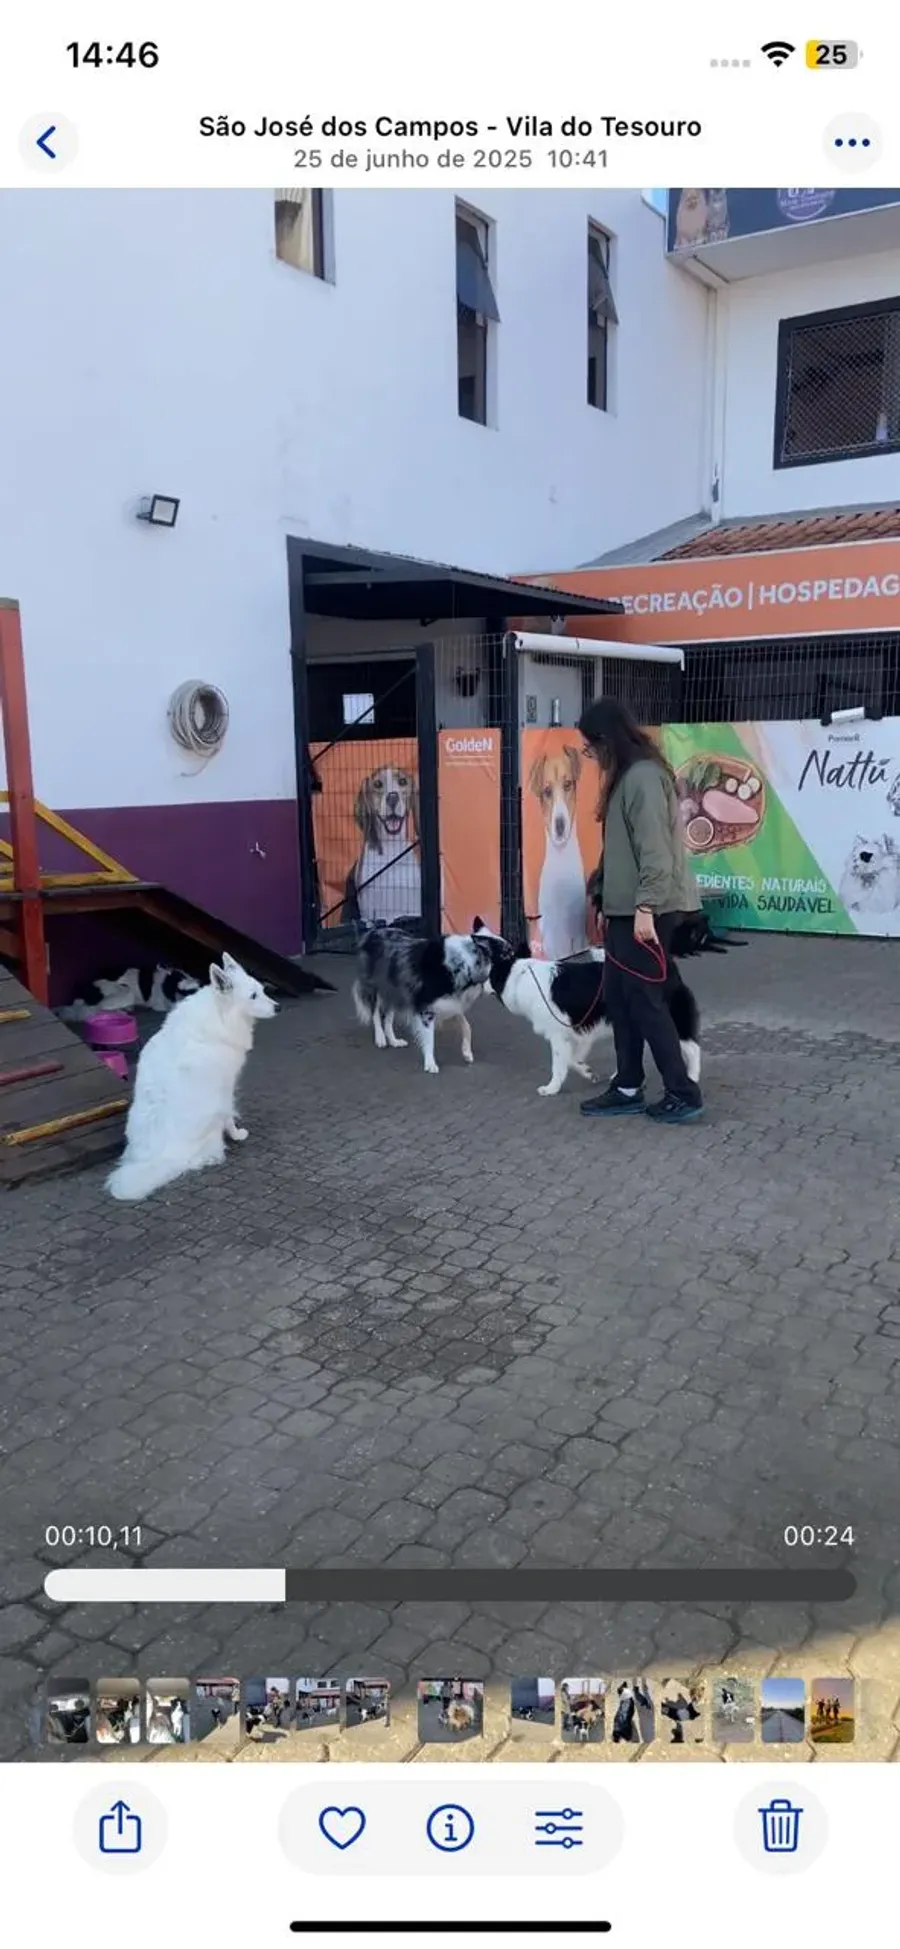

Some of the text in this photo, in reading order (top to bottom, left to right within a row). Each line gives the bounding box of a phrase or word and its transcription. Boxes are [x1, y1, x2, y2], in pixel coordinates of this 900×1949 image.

[759, 573, 900, 605] HOSPEDAG
[696, 873, 826, 893] EDIENTES NATURAIS
[757, 892, 835, 914] SAUDÁVEL
